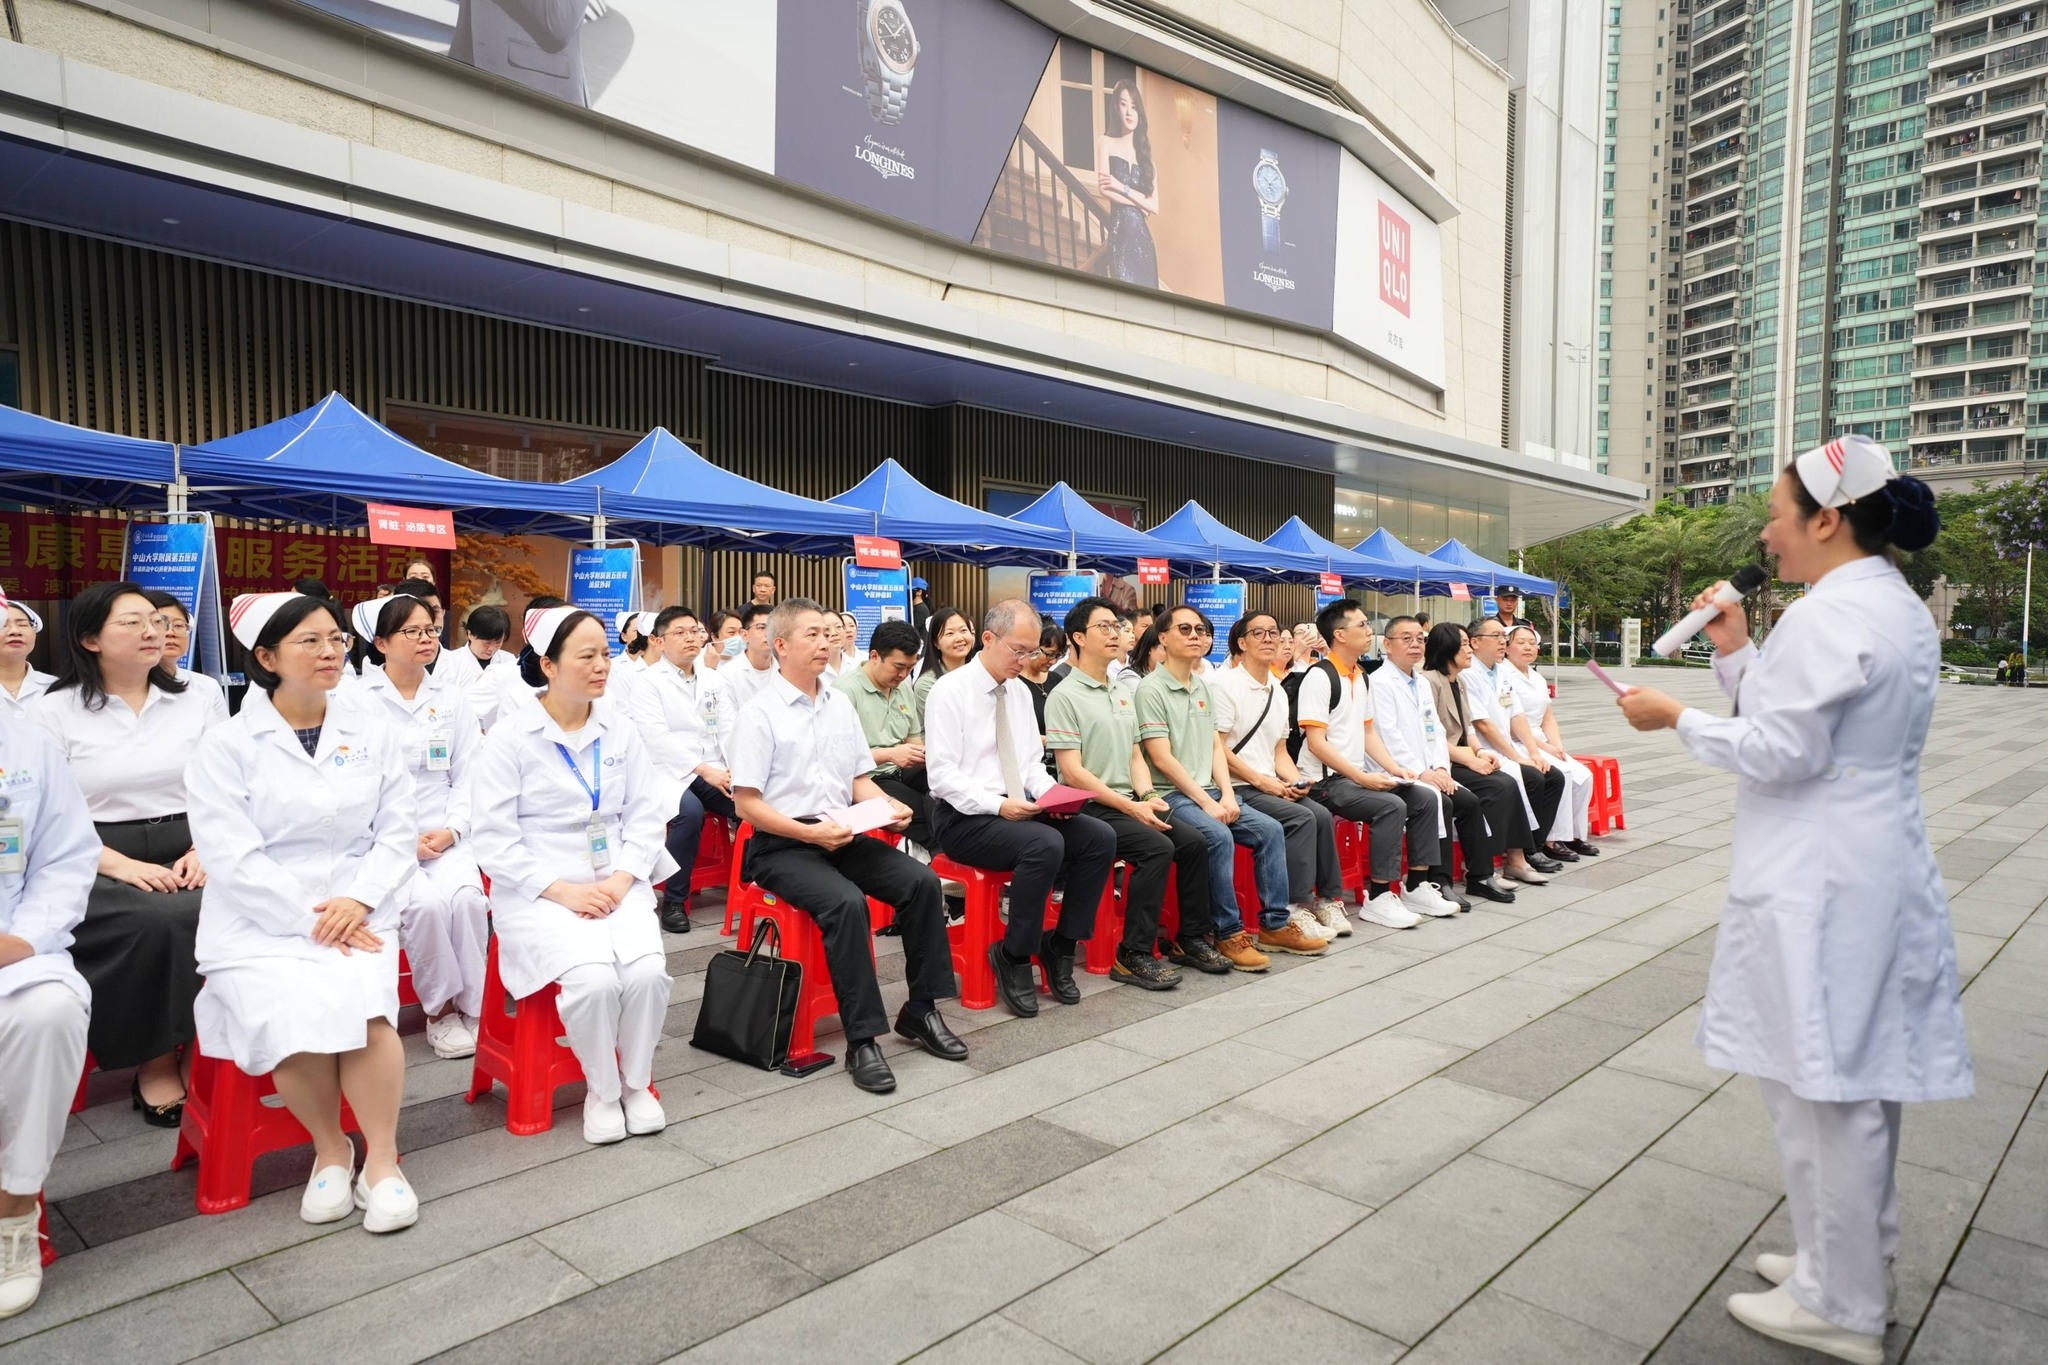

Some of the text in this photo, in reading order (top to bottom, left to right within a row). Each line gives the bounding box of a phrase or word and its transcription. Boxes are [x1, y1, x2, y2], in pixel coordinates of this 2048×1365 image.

[855, 145, 915, 179] LONGINES
[1381, 215, 1405, 264] UNI
[1253, 270, 1295, 290] LONGINES
[1382, 258, 1407, 303] QLO
[377, 519, 448, 535] 肾脏·泌尿专区
[132, 552, 198, 563] 中山大学附属第五医院
[573, 571, 628, 580] 中山大学附属第五医院
